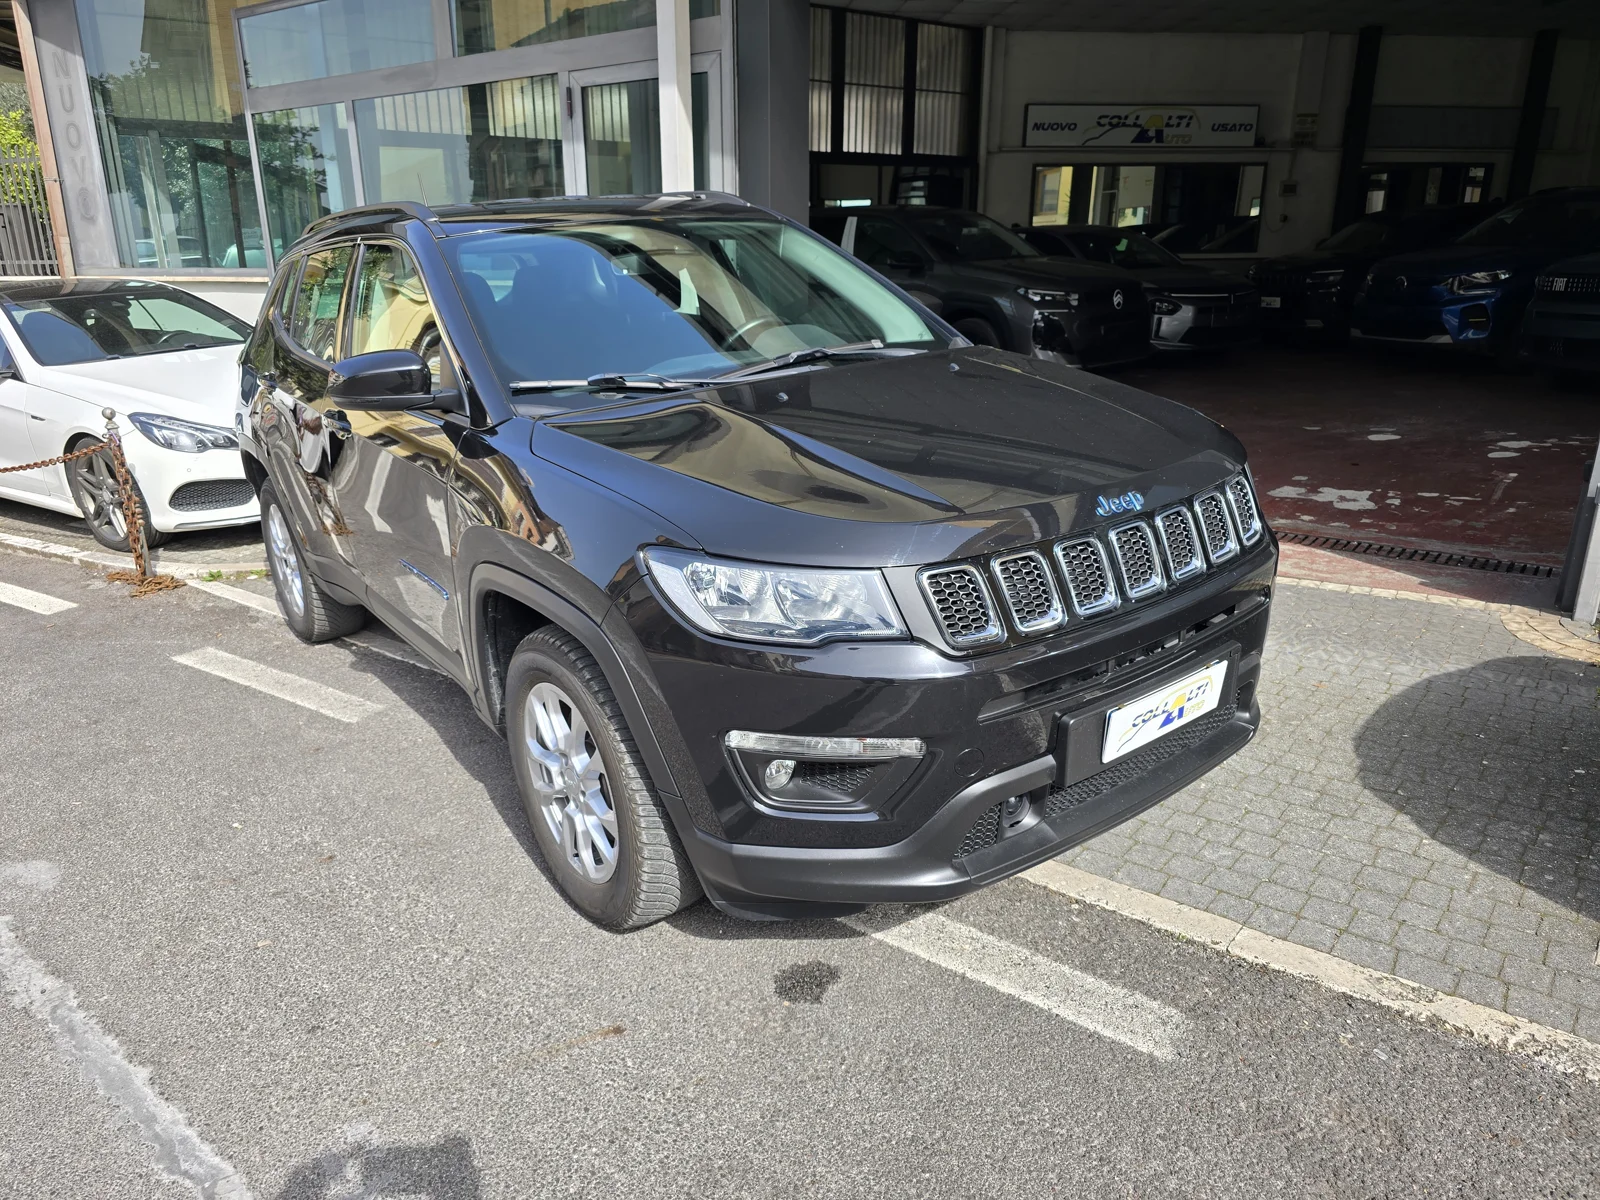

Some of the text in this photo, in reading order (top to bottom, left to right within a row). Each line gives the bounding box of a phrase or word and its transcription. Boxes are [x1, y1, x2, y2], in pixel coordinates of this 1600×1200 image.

[1032, 122, 1077, 131] NUOVO
[1096, 114, 1194, 128] COLLALTI
[1211, 123, 1254, 132] USATO
[52, 51, 96, 222] NUOVO
[1552, 278, 1568, 292] FIAT
[1095, 490, 1144, 517] Jeep
[1131, 682, 1209, 728] COLLALTI
